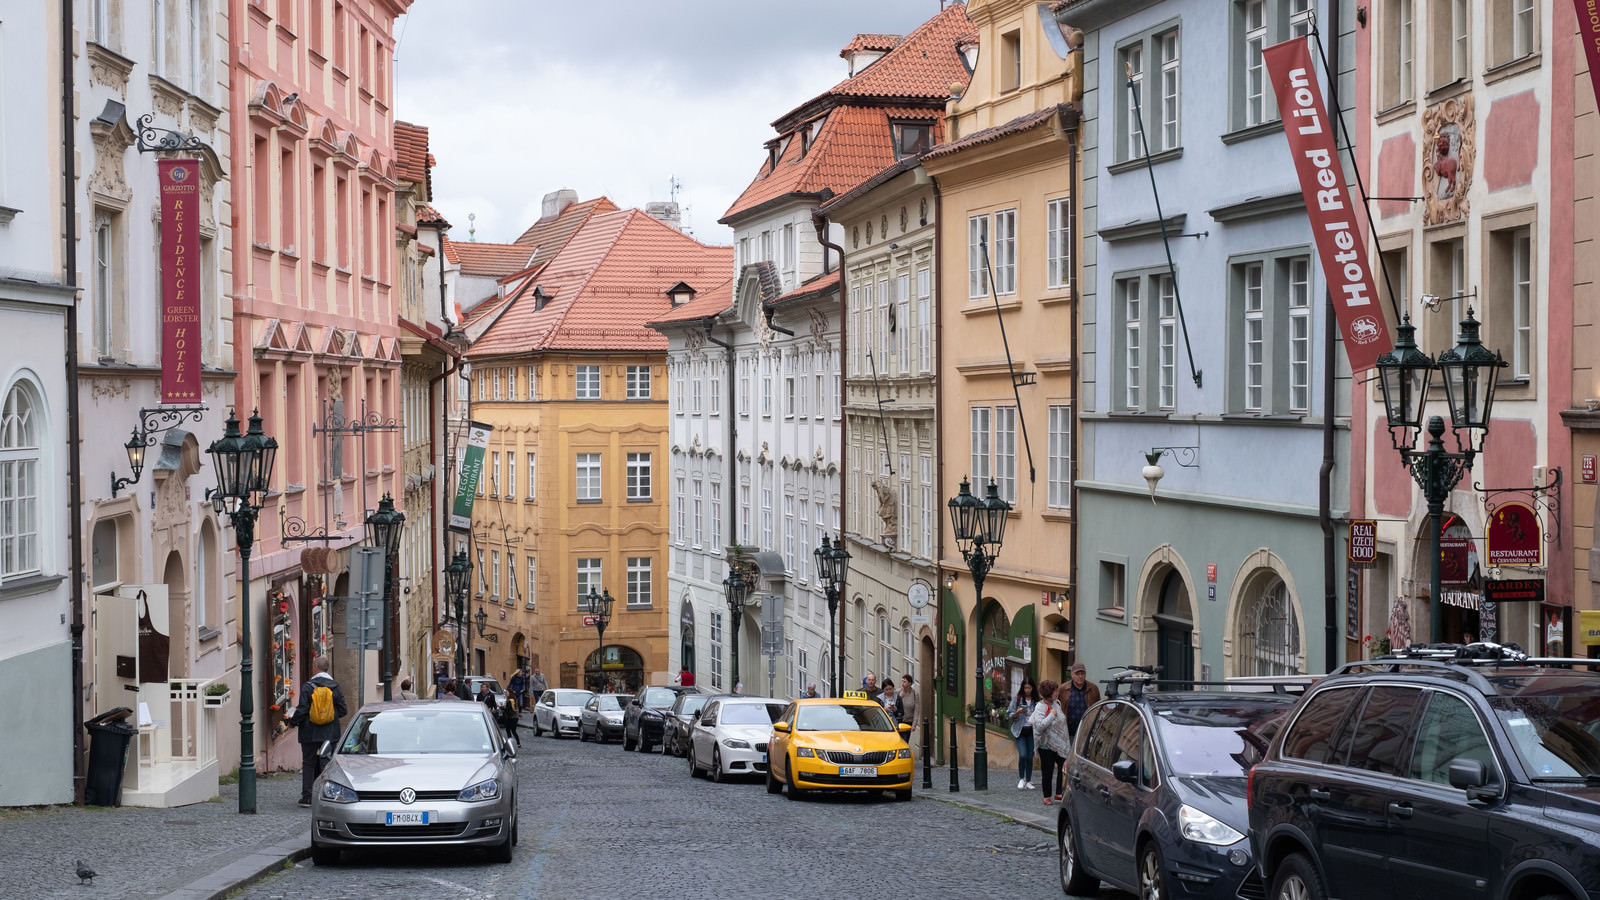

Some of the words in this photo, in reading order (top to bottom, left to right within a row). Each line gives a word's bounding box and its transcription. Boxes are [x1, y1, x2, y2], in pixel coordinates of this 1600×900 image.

[1288, 68, 1323, 136] Lion
[1305, 148, 1344, 212] Red
[174, 200, 186, 300] RESIDENCE
[1325, 221, 1371, 307] Hotel
[163, 315, 199, 323] LOBSTER
[167, 306, 195, 314] GREEN
[175, 328, 186, 383] HOTEL
[458, 464, 471, 497] VEGAN
[465, 459, 481, 507] RESTAURANT
[1352, 536, 1374, 547] CZECH
[1353, 525, 1374, 537] REAL
[1352, 546, 1374, 558] FOOD
[1487, 581, 1542, 591] GARDEN
